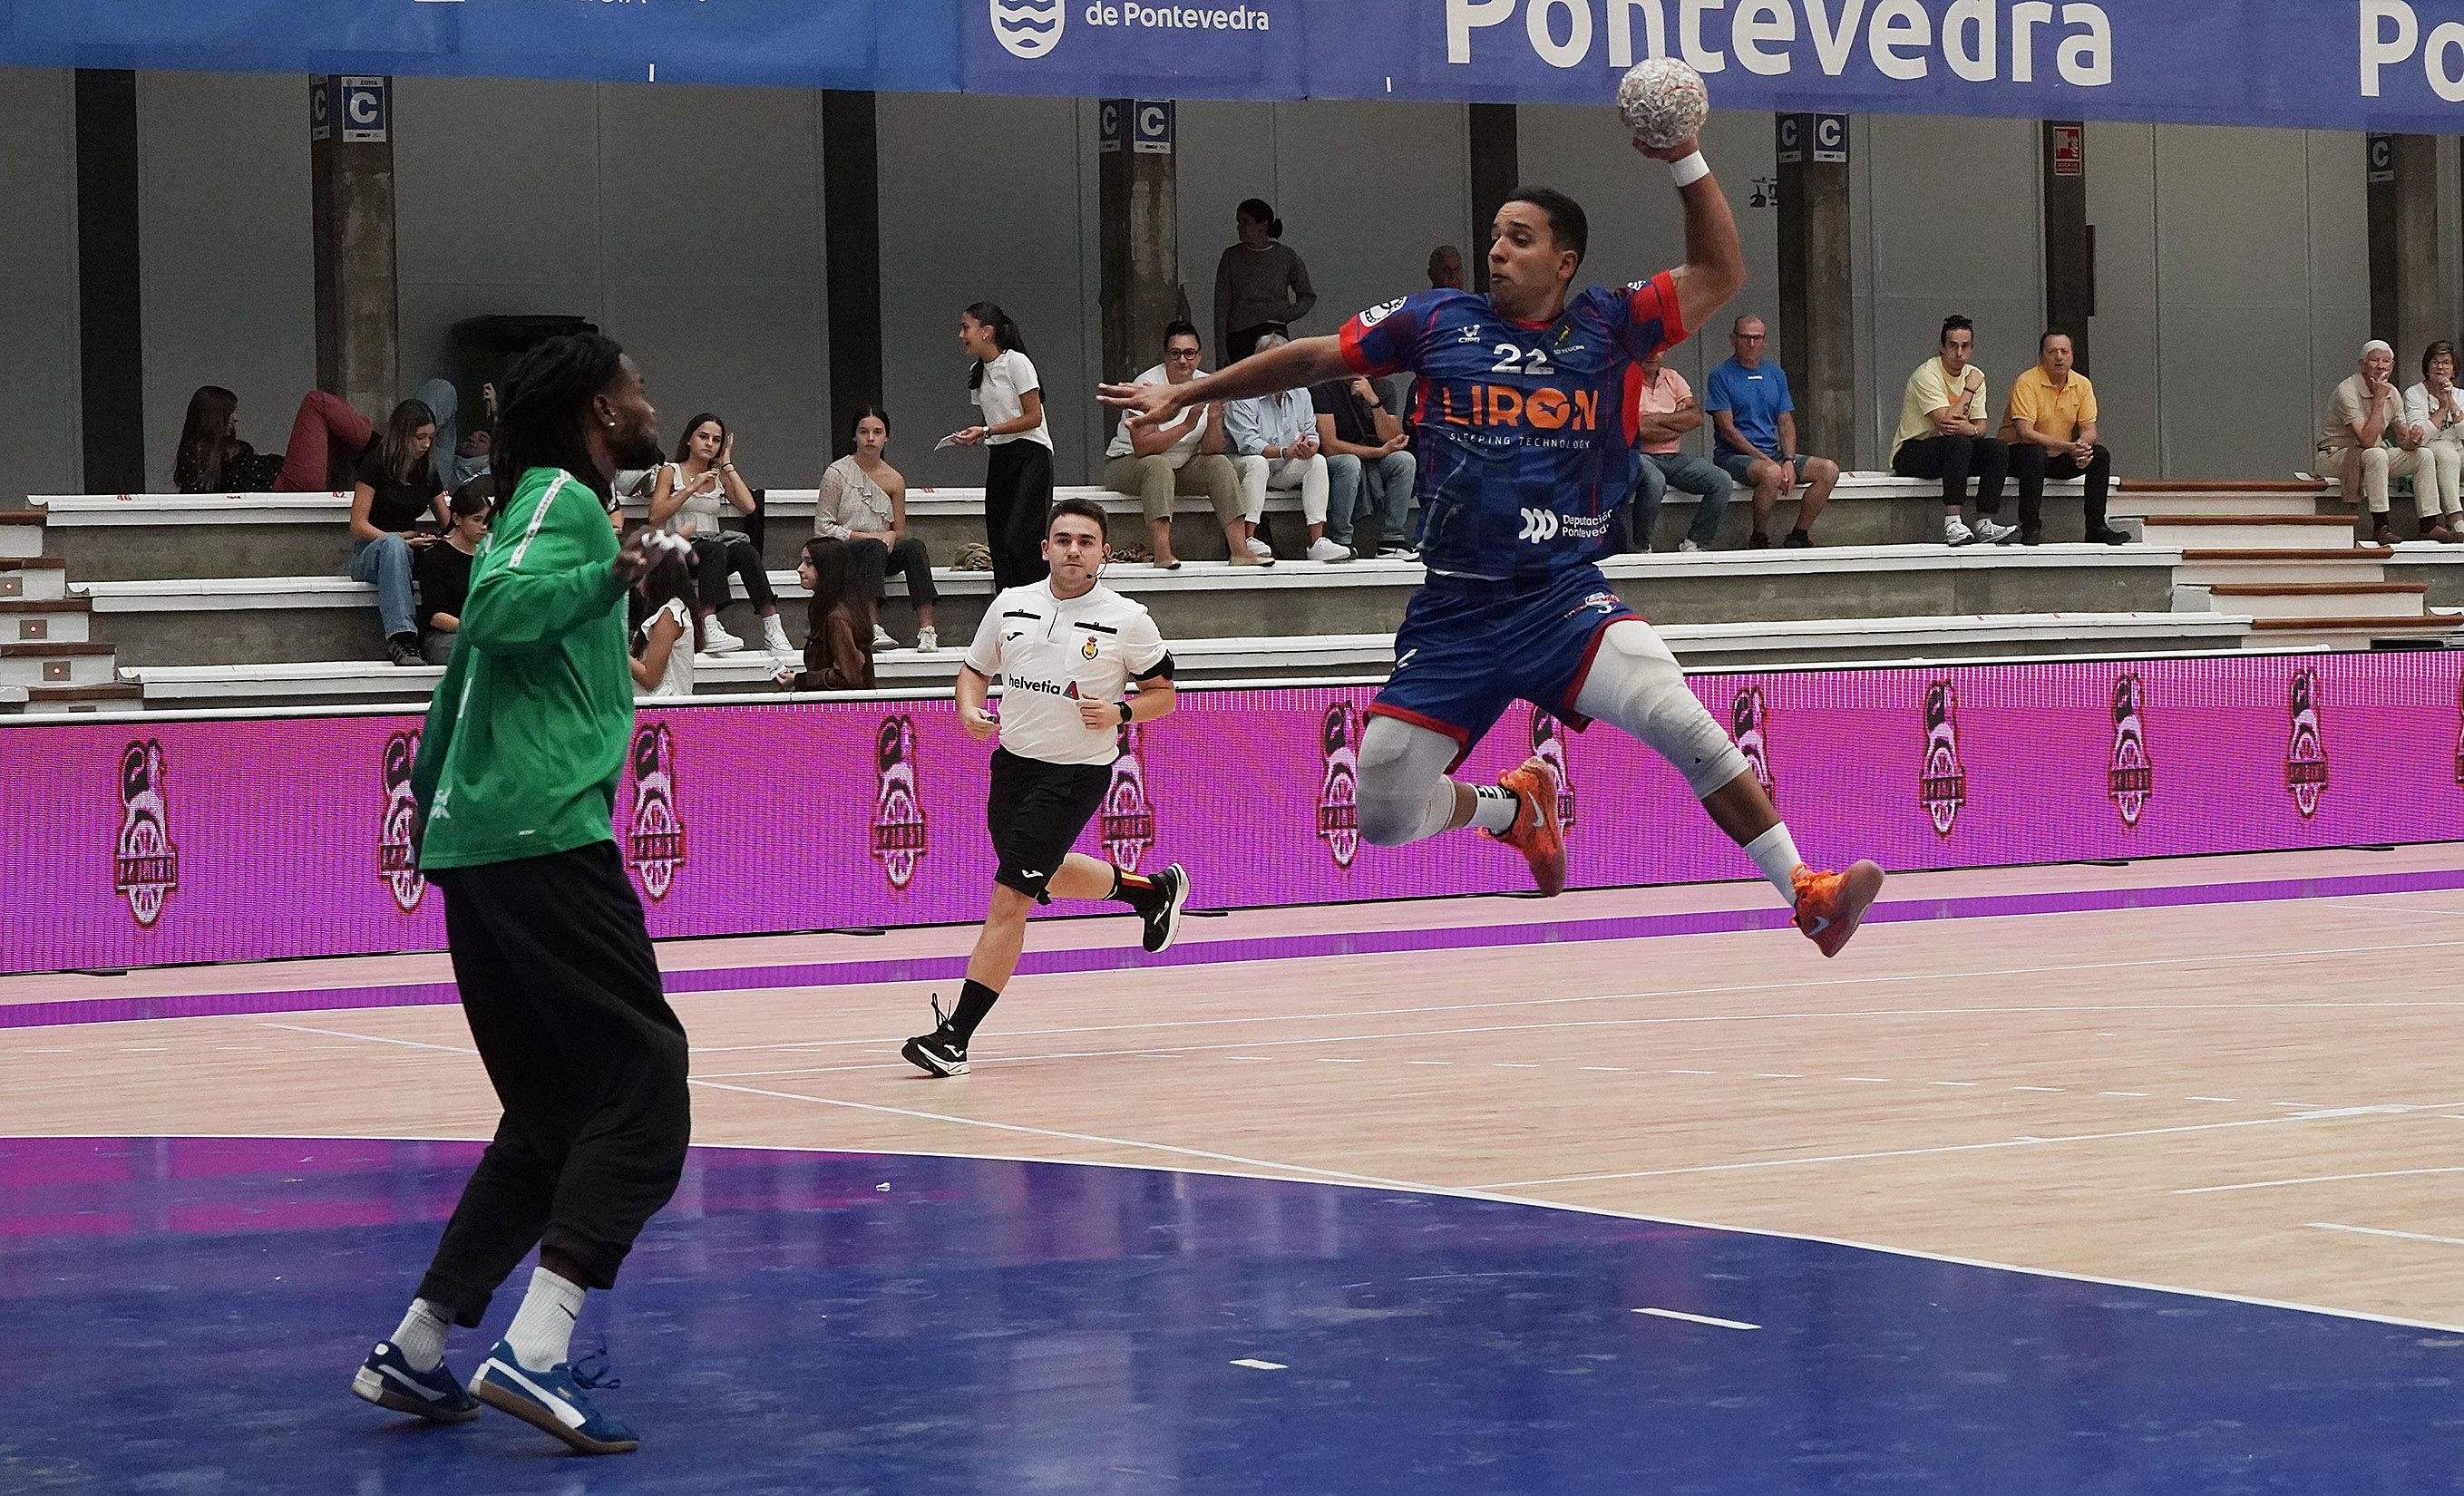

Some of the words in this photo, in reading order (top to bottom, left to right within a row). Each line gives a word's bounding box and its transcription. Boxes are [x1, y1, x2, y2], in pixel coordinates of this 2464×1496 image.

[1085, 0, 1119, 26] de
[1124, 2, 1270, 31] Pontevedra
[1445, 0, 2113, 87] Pontevedra
[314, 89, 326, 121] C
[349, 92, 378, 124] C
[1102, 105, 1117, 135] C
[1140, 107, 1164, 136] C
[1781, 119, 1797, 146] C
[1818, 119, 1841, 146] C
[2371, 141, 2389, 167] C
[1491, 343, 1554, 374] 22
[1442, 384, 1599, 431] LIRON
[1449, 432, 1511, 446] SLEEPING
[1519, 436, 1591, 450] TECHNOLOGY
[1008, 673, 1061, 695] helvetia
